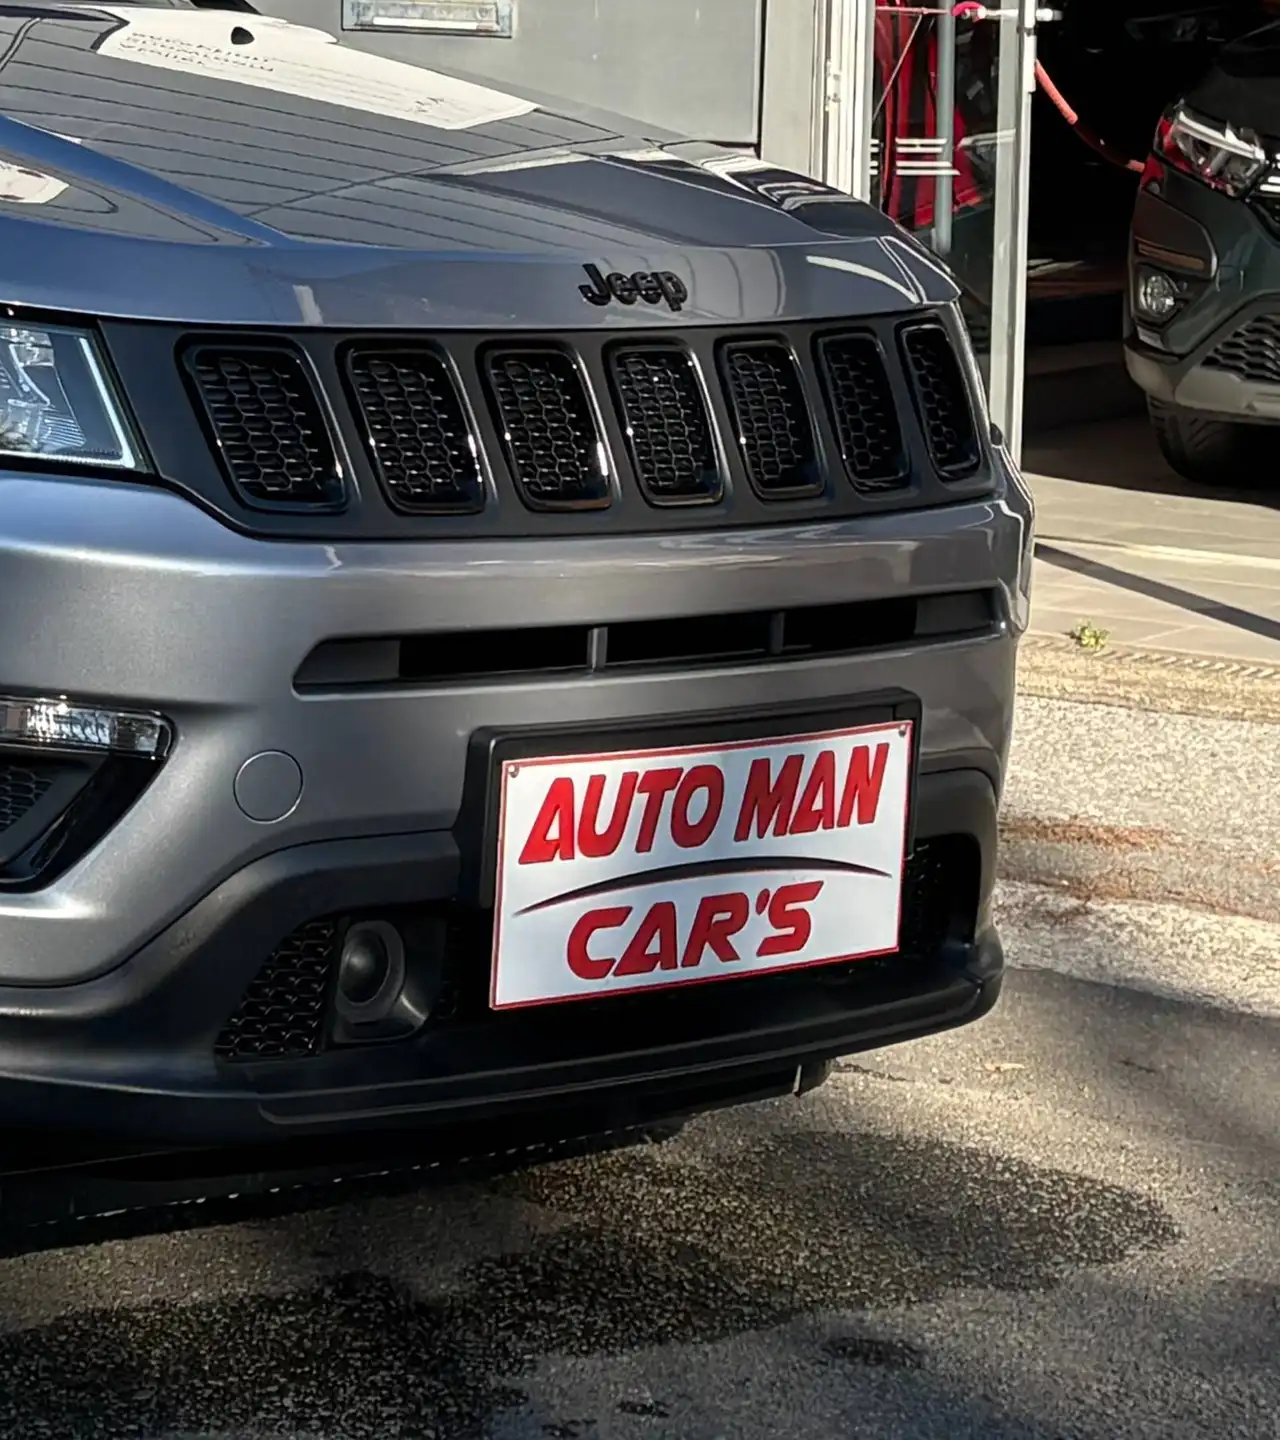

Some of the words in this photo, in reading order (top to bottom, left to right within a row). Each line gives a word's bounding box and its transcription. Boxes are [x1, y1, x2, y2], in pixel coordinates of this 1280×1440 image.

[578, 263, 688, 312] Jeep
[518, 764, 725, 865] AUTO
[734, 742, 890, 842] MAN
[566, 880, 824, 980] CAR'S
